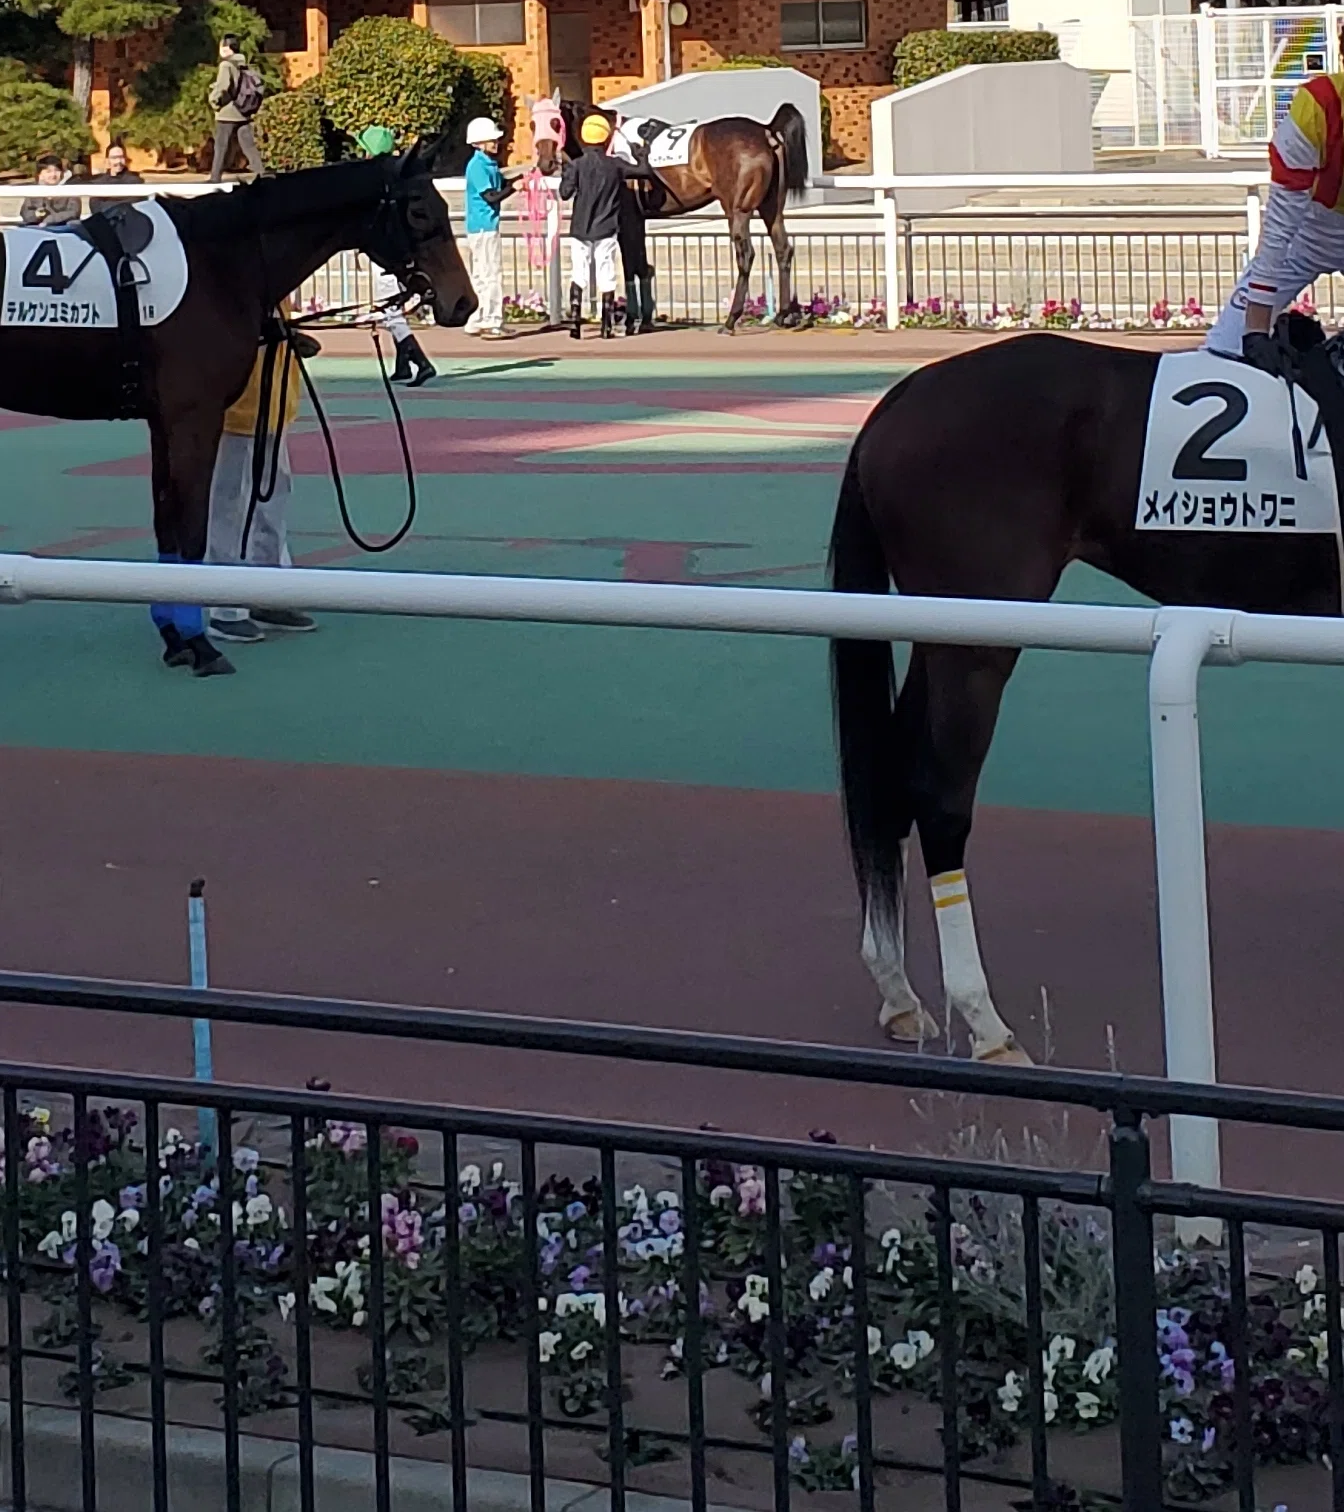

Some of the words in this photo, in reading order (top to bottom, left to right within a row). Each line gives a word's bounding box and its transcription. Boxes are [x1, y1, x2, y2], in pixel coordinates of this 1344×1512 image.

[667, 127, 687, 150] 9
[22, 239, 71, 295] 4
[1171, 381, 1249, 481] 2
[1143, 490, 1296, 528] メイショウトワニ
